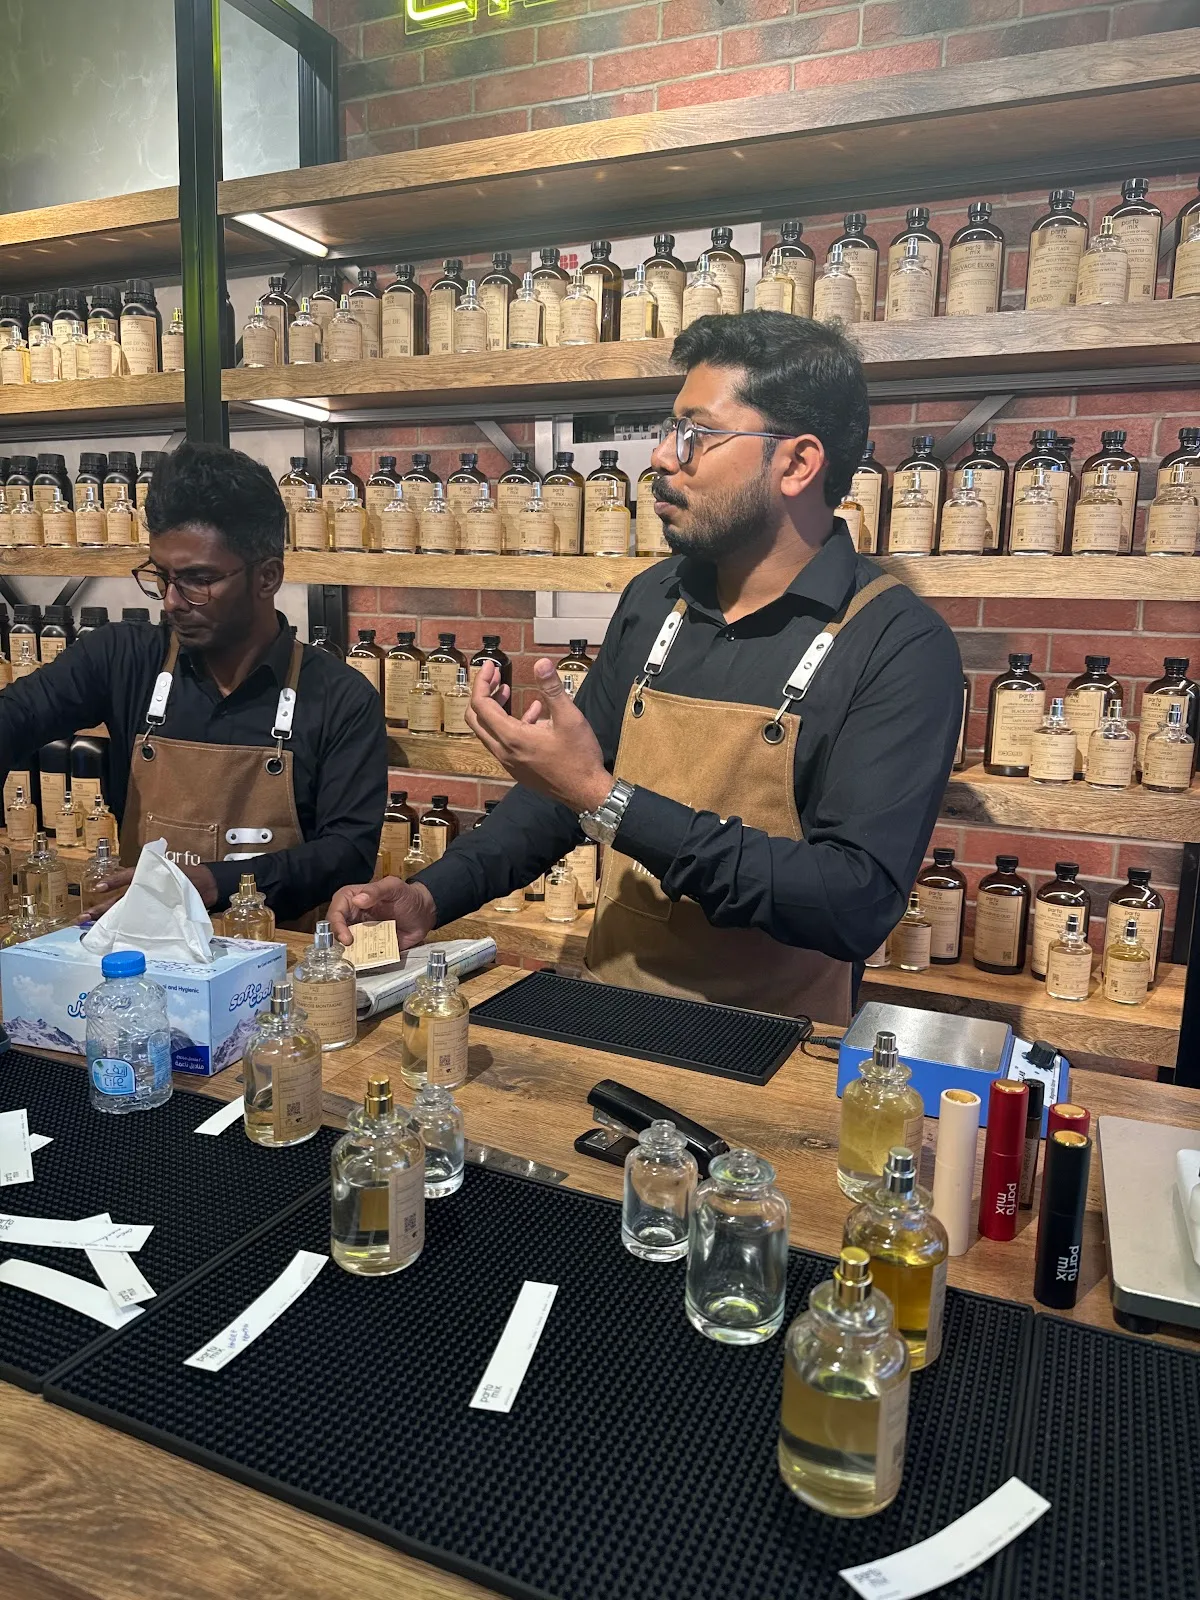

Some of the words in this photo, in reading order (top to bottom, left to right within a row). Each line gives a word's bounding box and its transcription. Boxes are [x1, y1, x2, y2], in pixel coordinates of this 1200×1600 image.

[559, 254, 578, 269] BB
[229, 983, 254, 1012] Soft
[249, 979, 274, 1008] Cool
[995, 1192, 1007, 1215] mix
[1056, 1256, 1069, 1282] mix
